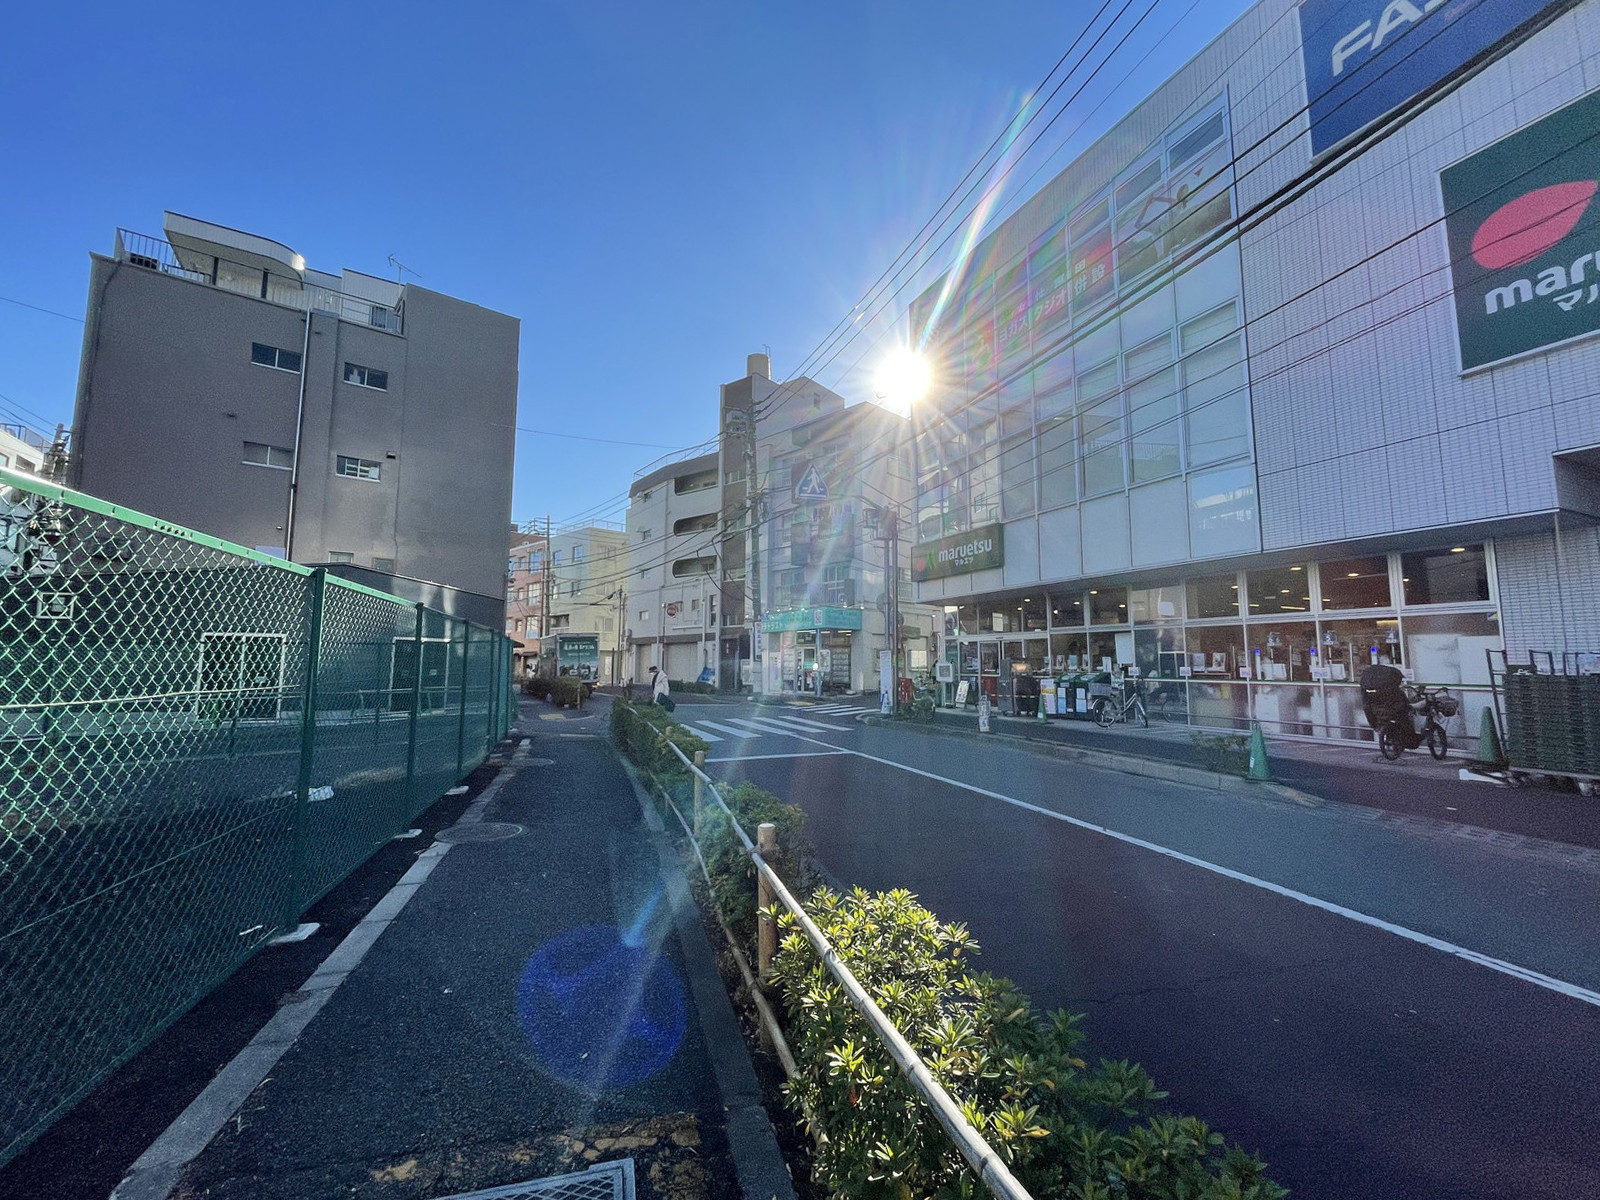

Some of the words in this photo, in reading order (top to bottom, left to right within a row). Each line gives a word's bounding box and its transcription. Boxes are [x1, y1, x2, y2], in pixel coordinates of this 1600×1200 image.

[1331, 0, 1448, 77] FA
[1485, 250, 1600, 315] mar
[938, 538, 992, 562] maruetsu
